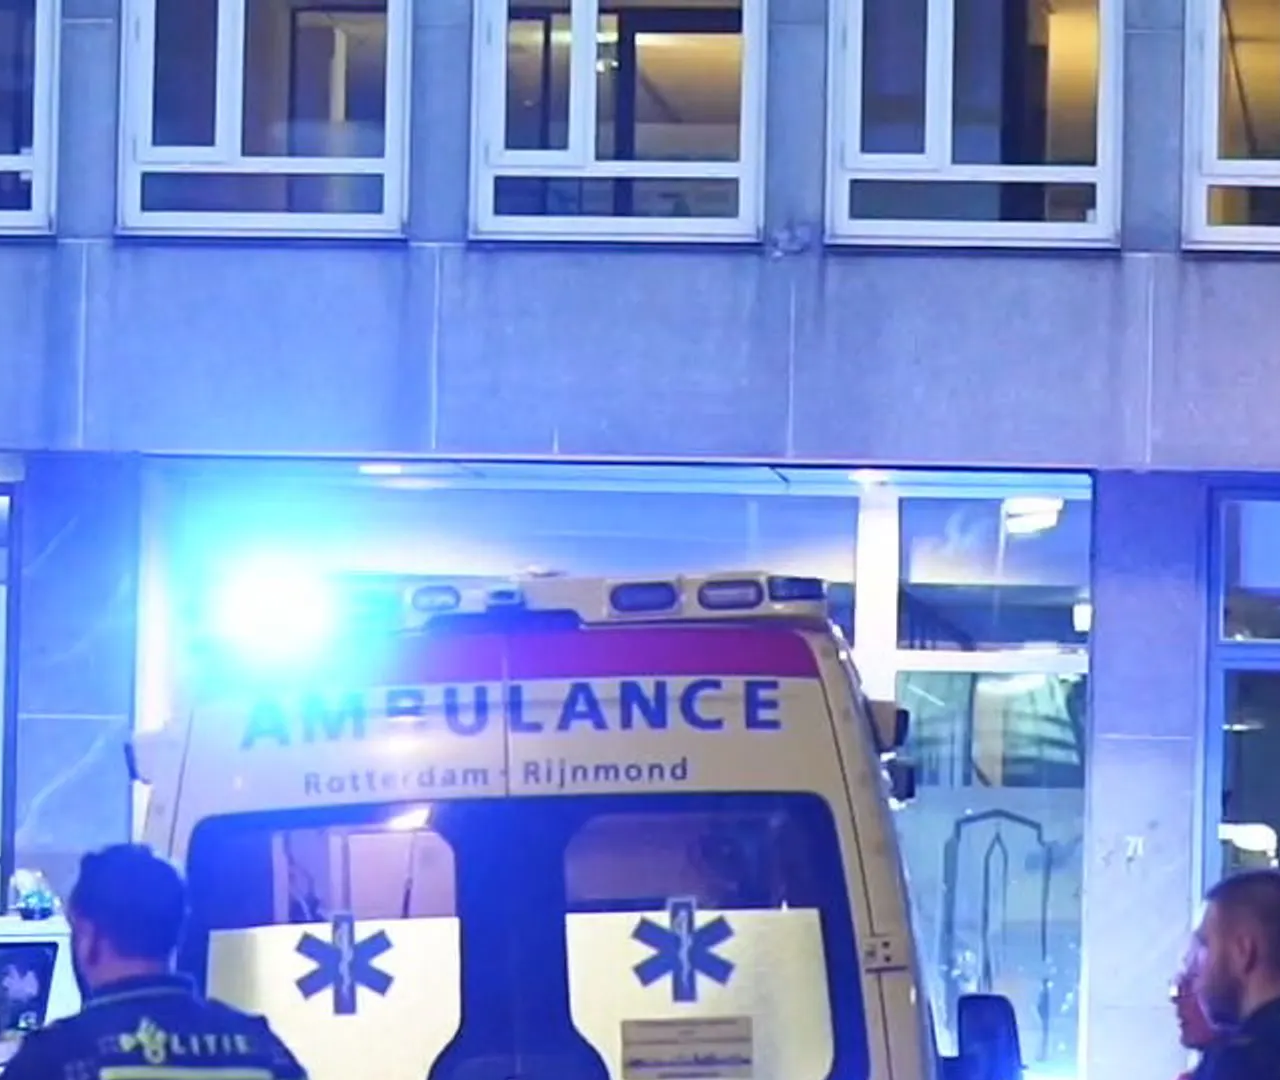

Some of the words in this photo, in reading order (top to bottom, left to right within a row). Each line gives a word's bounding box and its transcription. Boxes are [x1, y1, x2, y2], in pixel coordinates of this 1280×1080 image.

[241, 679, 782, 749] AMBULANCE
[303, 766, 489, 796] Rotterdam
[523, 757, 688, 788] Rijnmond
